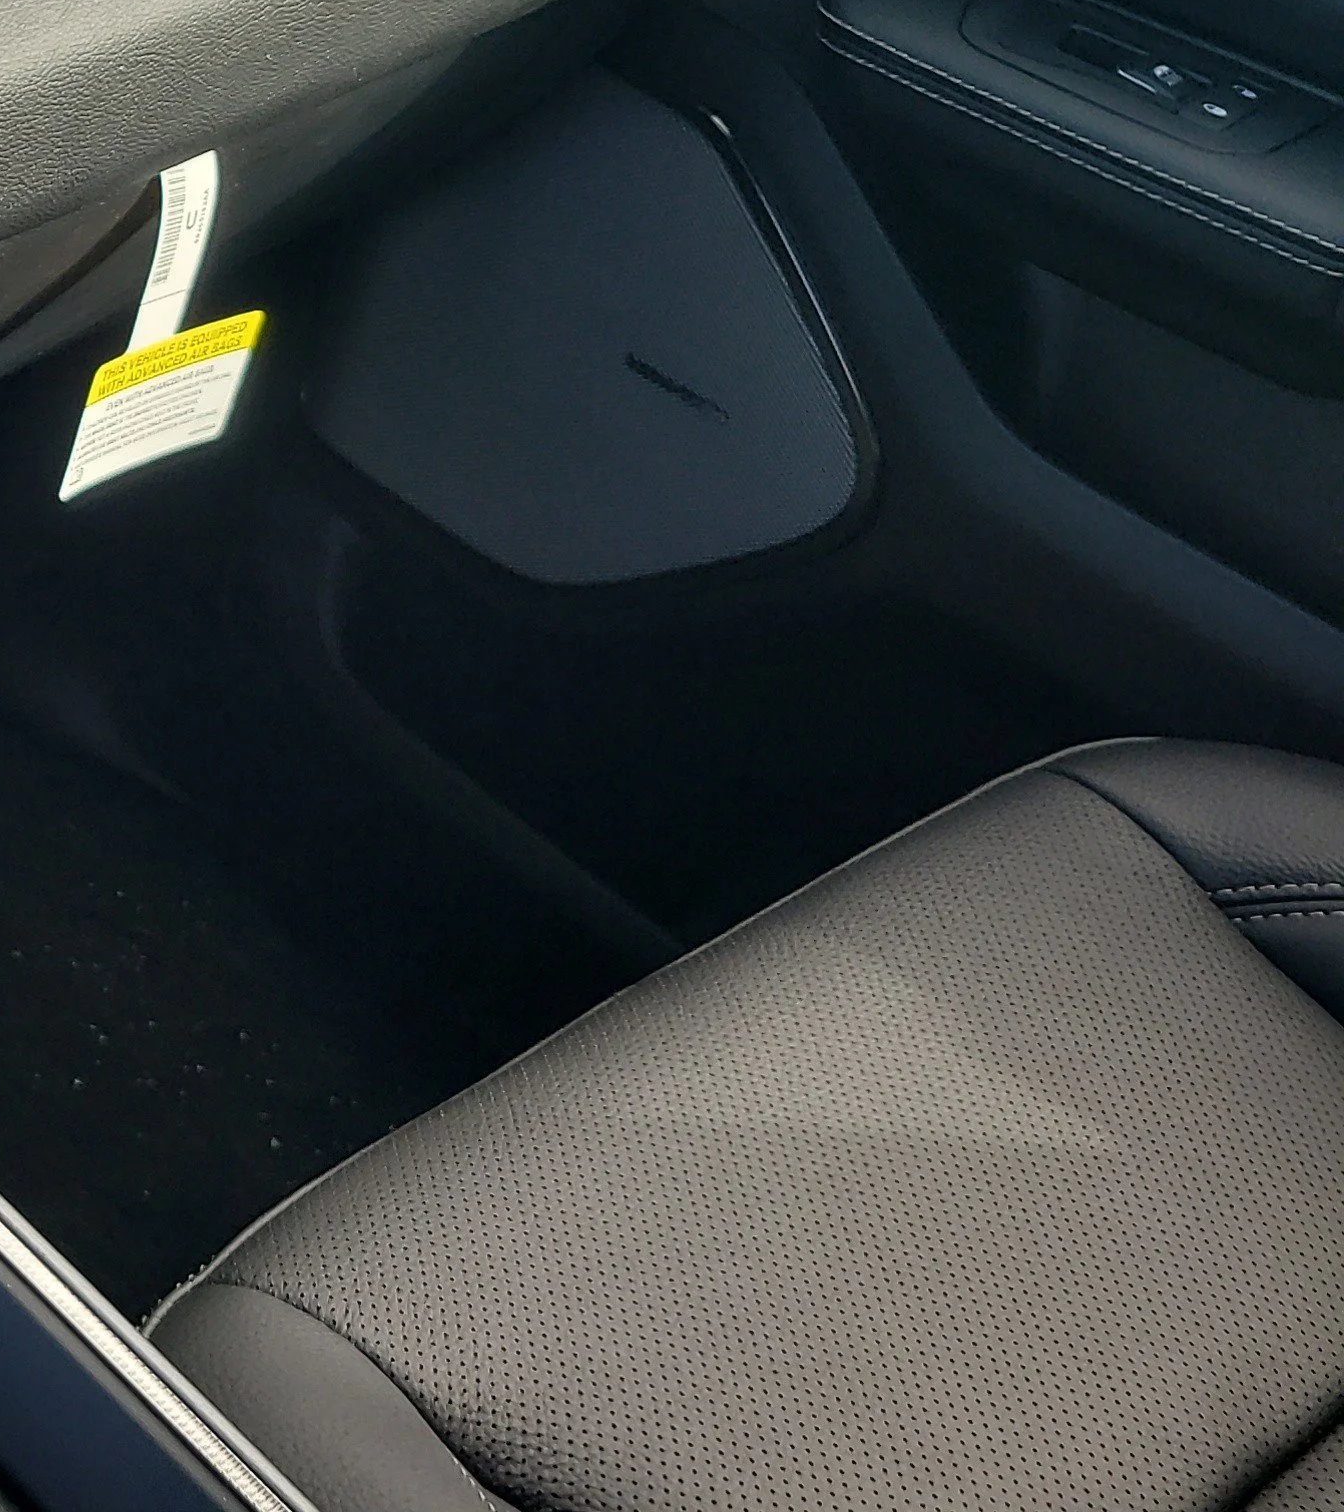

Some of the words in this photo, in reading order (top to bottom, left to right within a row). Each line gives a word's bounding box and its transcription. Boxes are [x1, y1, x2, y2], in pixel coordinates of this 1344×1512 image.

[129, 343, 173, 369] VEHICLE
[189, 320, 249, 348] EQUIPPED
[126, 354, 188, 387] ADVANCED
